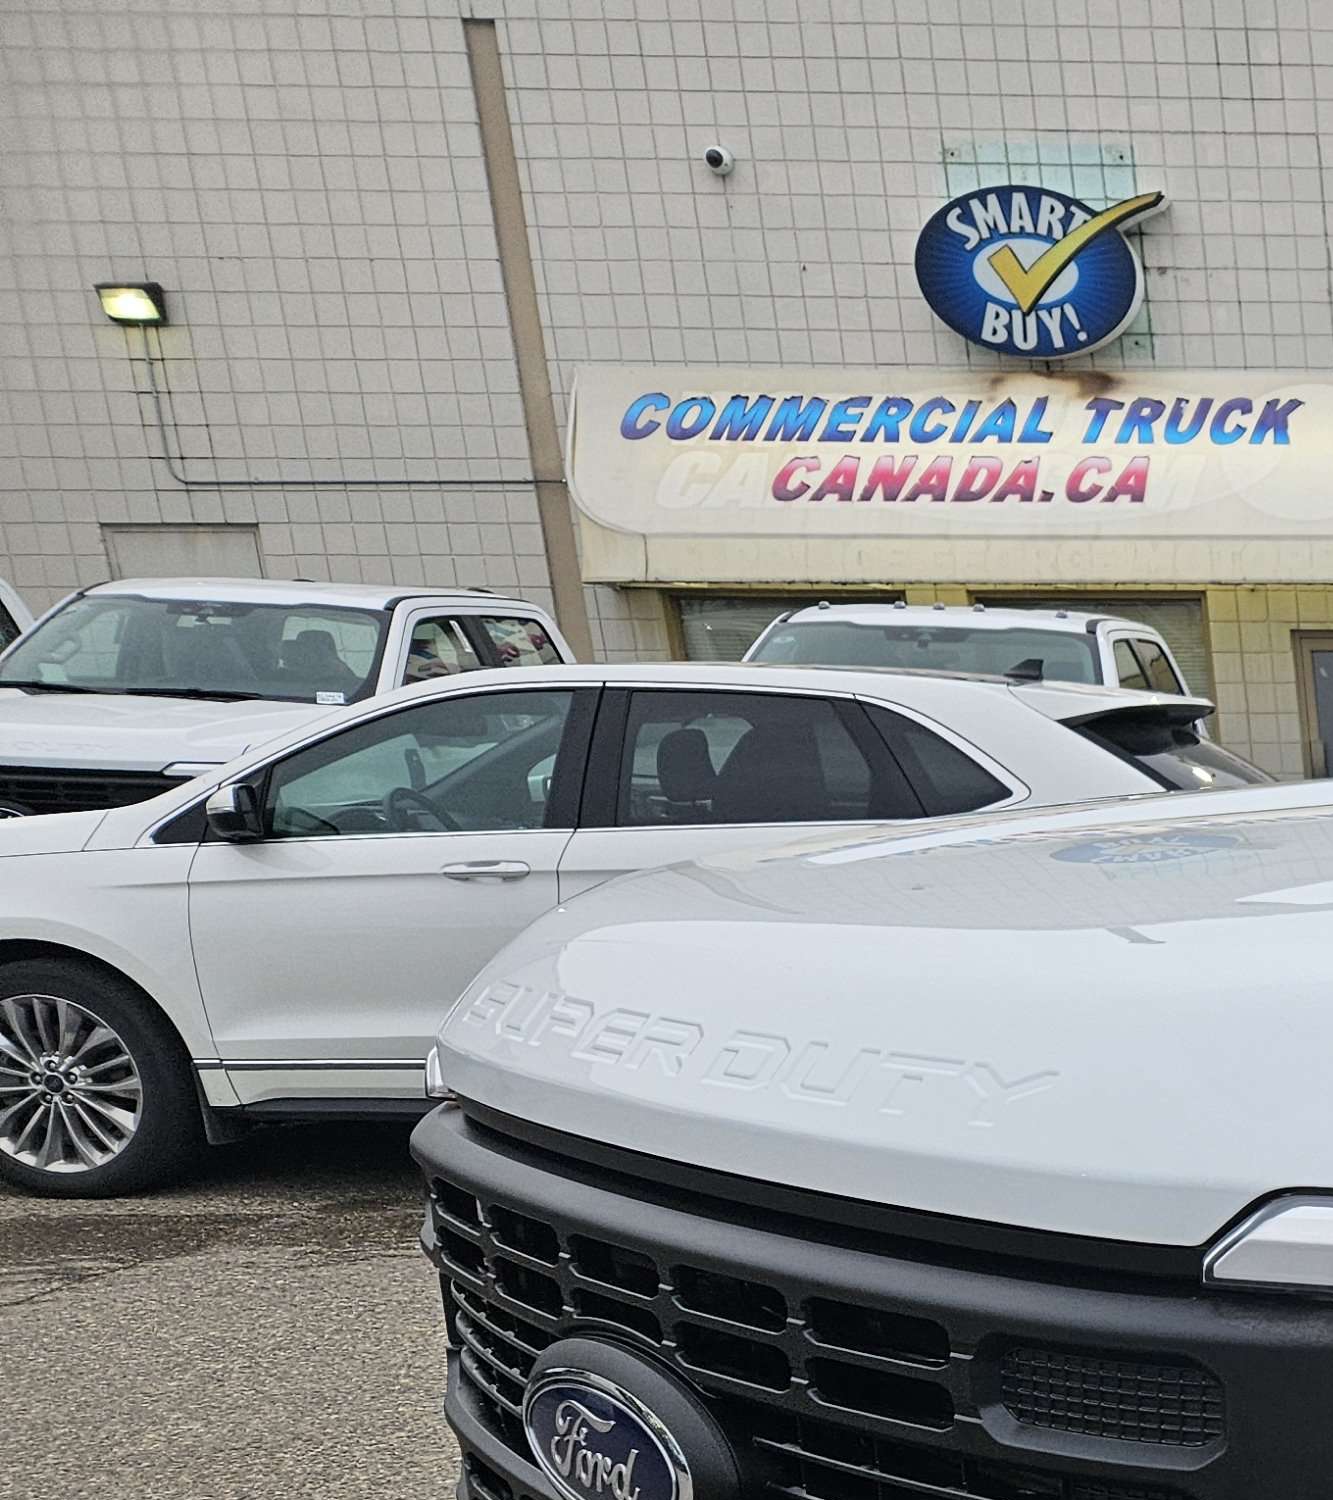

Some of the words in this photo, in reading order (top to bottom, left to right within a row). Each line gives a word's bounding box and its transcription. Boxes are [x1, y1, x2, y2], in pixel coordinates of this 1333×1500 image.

[946, 191, 1094, 251] SMART
[980, 301, 1088, 351] BUY!
[620, 392, 1053, 444] COMMERCIAL
[1081, 397, 1305, 446] TRUCK
[771, 454, 1152, 504] CANADA.CA
[463, 979, 703, 1078] SUPER
[699, 1028, 1061, 1127] DUTY
